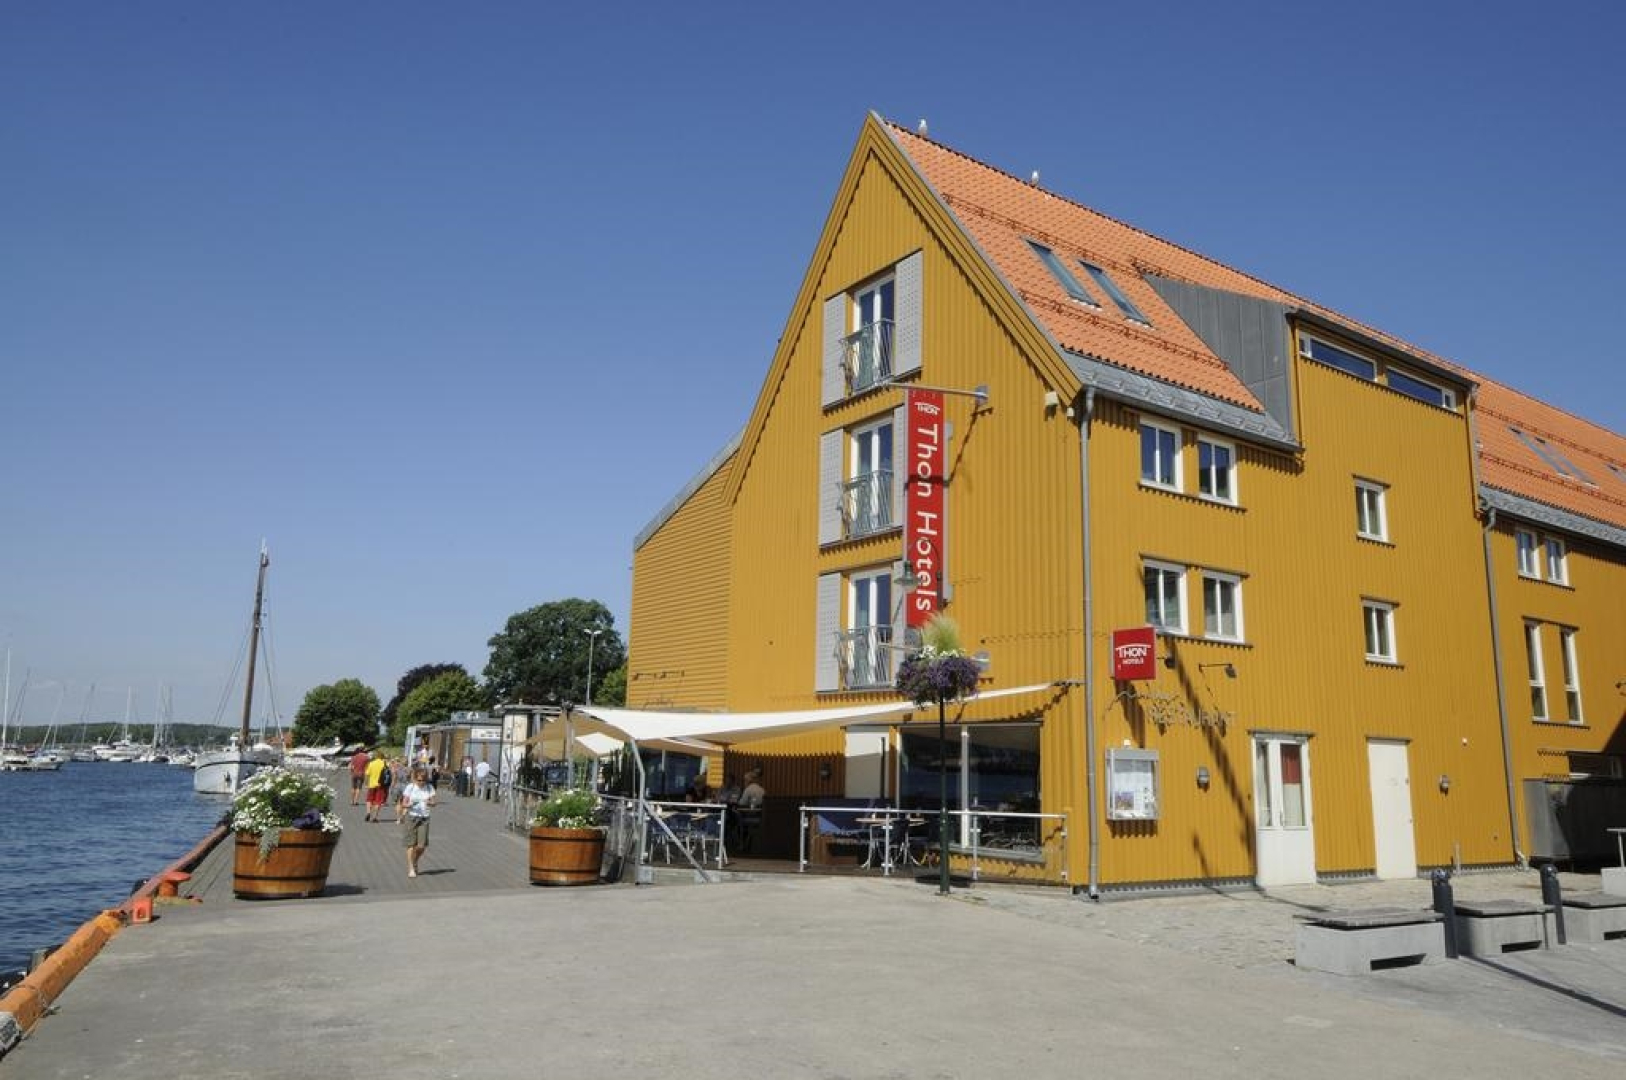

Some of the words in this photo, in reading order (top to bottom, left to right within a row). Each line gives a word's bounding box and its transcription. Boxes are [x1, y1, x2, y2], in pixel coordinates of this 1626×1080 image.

[914, 402, 940, 416] THON
[917, 423, 939, 498] Thon
[915, 510, 938, 611] Hotels
[1115, 643, 1151, 658] THON
